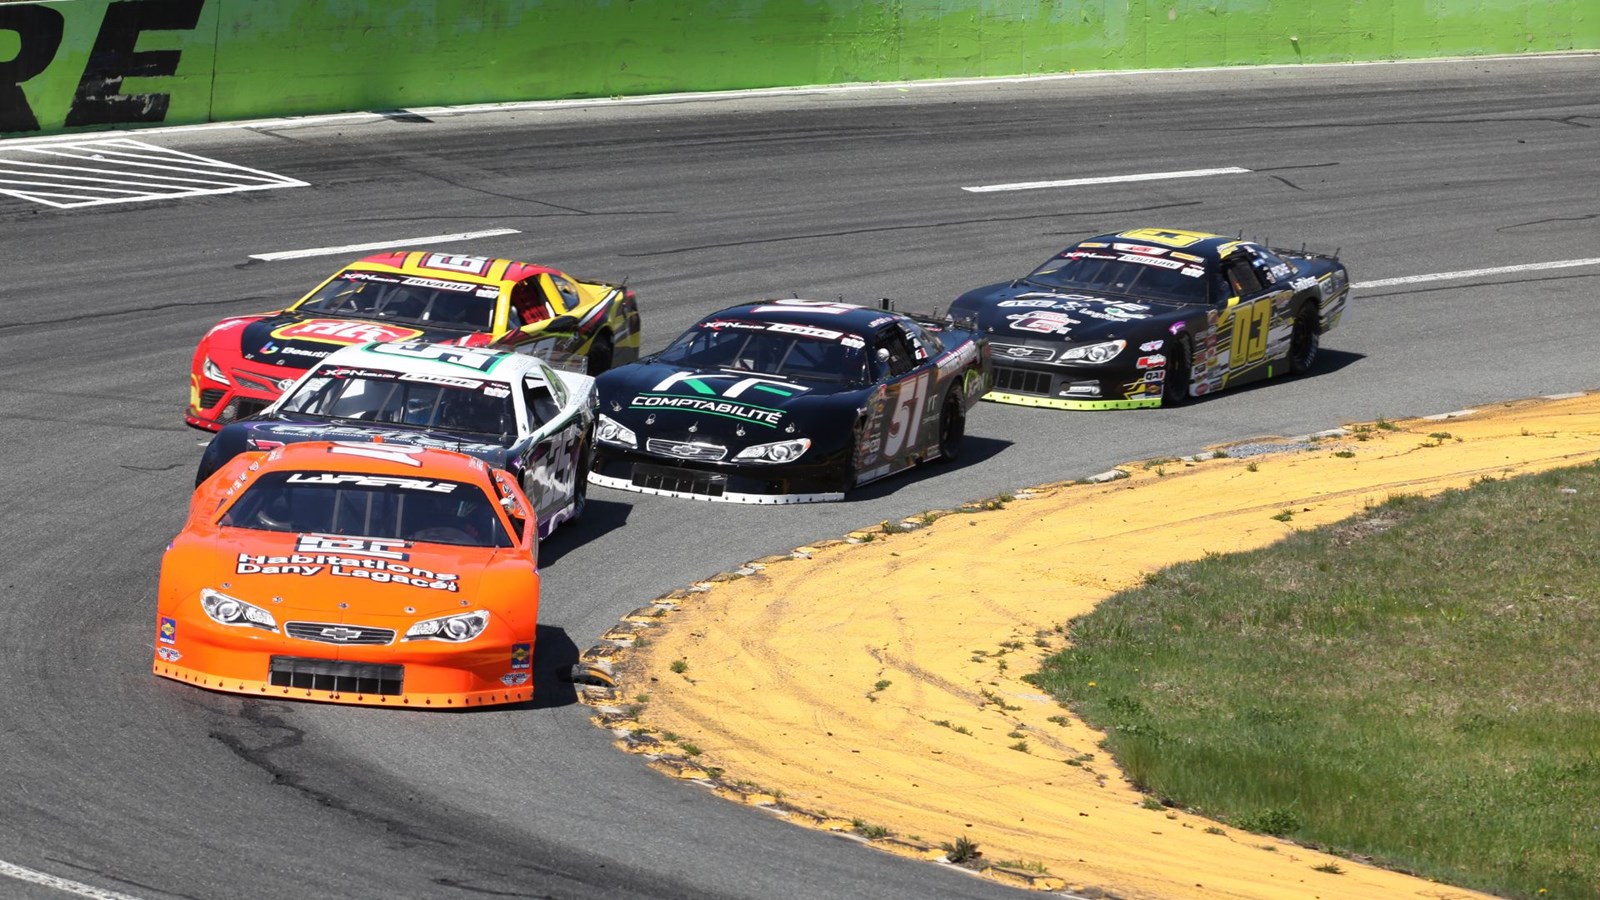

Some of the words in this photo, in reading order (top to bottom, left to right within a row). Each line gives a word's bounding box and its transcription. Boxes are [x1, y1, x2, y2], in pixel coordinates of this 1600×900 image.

[1230, 297, 1272, 370] 03
[631, 396, 783, 425] COMPTABILITÉ
[884, 372, 929, 457] 51
[287, 474, 458, 493] LAPERLE
[236, 553, 460, 581] Habitations
[236, 563, 325, 576] Dany
